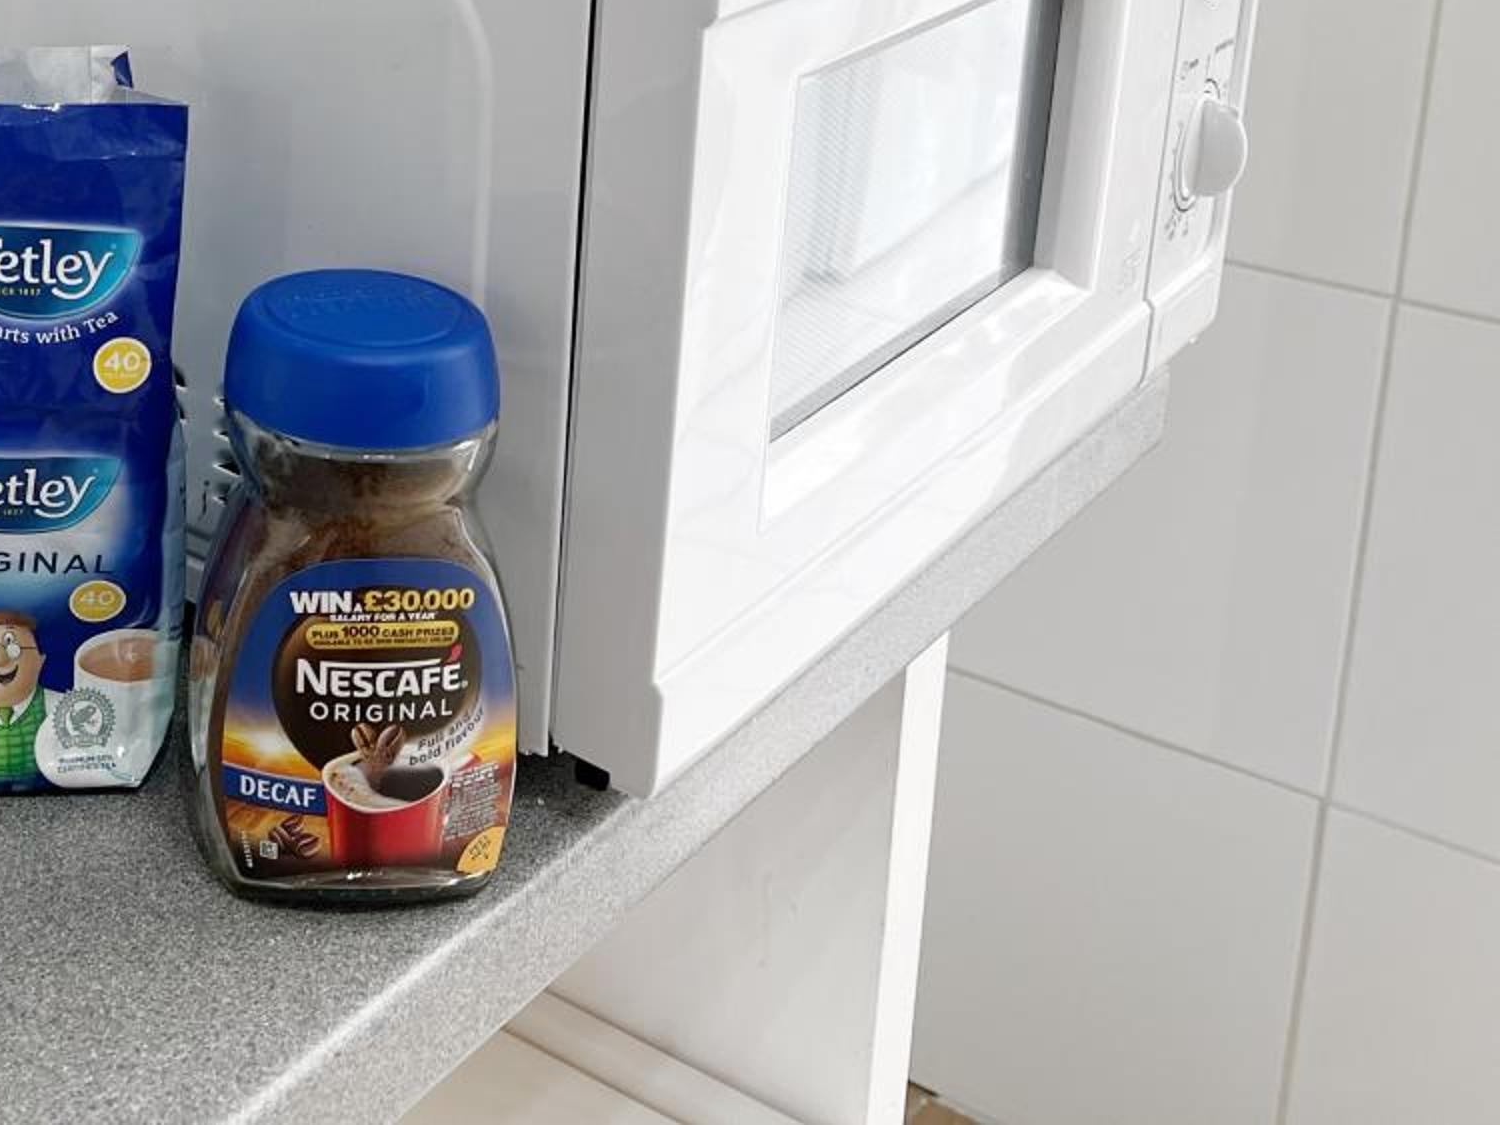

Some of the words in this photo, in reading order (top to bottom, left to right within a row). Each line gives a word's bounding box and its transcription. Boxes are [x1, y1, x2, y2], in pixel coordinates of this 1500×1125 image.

[35, 324, 81, 344] with
[83, 311, 118, 334] Tea
[102, 350, 141, 372] 40
[289, 590, 352, 614] WIN
[353, 602, 363, 613] A
[373, 613, 396, 622] FOR
[312, 630, 339, 639] PLUS
[341, 625, 380, 638] 1000
[381, 628, 413, 638] CASH
[309, 699, 453, 723] ORIGINAL
[417, 730, 445, 752] Full
[408, 745, 441, 767] bold
[239, 774, 318, 809] DECAF
